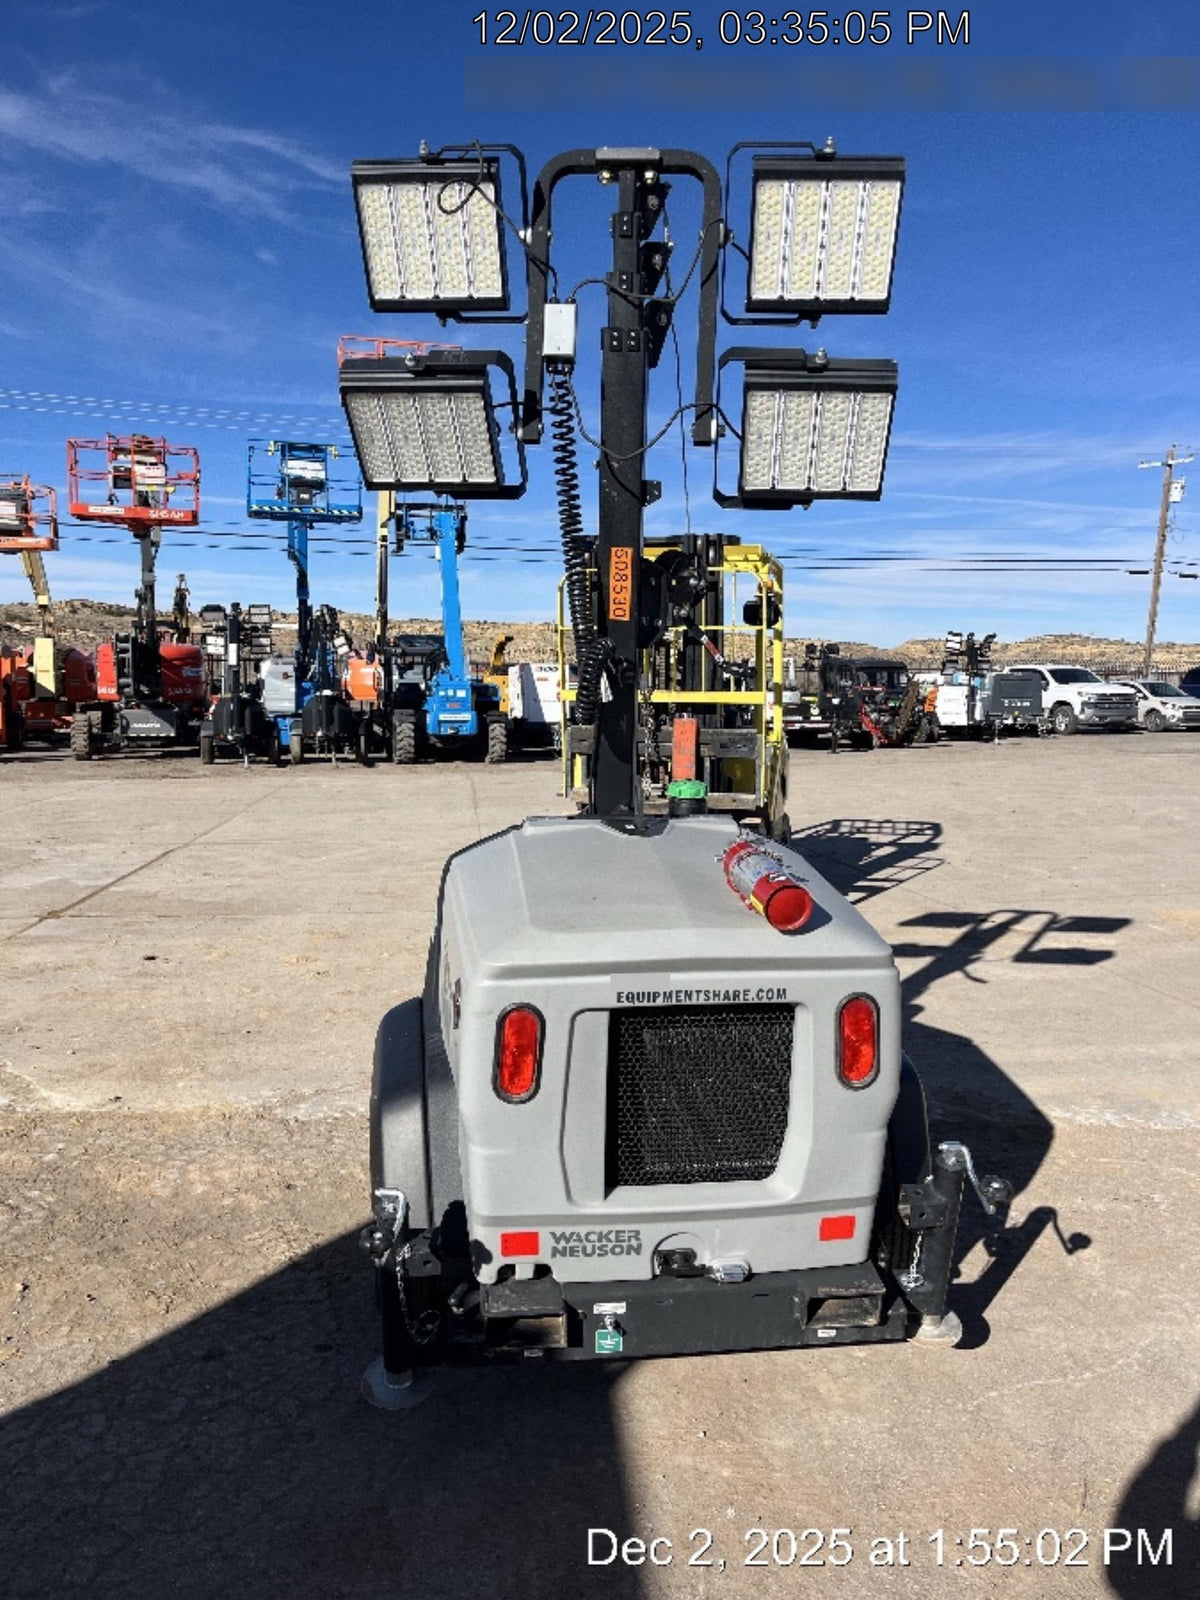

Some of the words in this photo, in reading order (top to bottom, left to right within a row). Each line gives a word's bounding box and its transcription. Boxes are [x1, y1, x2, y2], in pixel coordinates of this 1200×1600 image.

[616, 987, 787, 1005] EQUIPMENTSHARE.COM
[549, 1230, 642, 1245] WACKER
[551, 1243, 643, 1259] NEUSON
